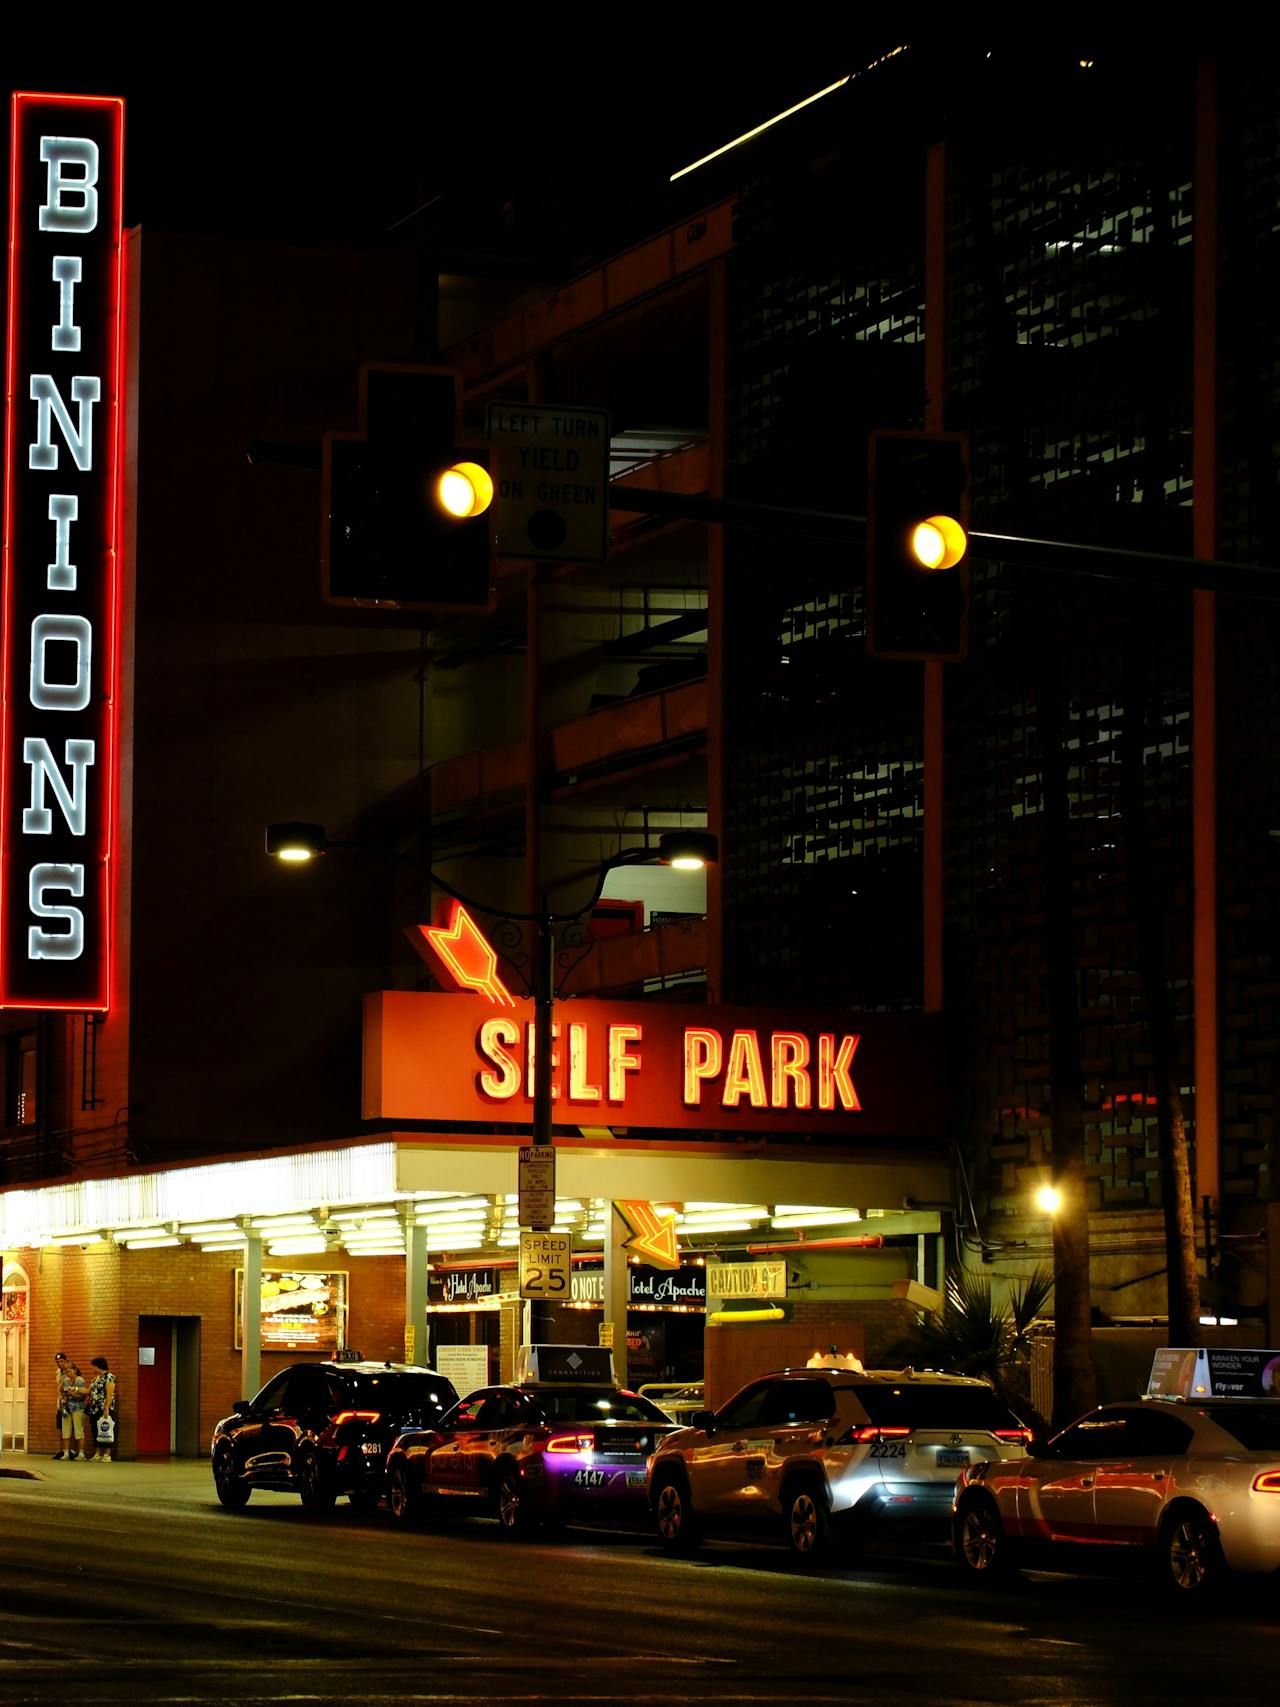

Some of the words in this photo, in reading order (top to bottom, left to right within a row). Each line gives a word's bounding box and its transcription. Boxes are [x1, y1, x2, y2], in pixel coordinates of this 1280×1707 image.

[498, 414, 542, 433] LEFT
[552, 416, 599, 438] TURN
[519, 447, 579, 471] YIELD
[499, 479, 523, 498] ON
[538, 482, 596, 505] GREEN
[22, 136, 101, 961] BINIONS
[683, 1026, 861, 1111] PARK
[520, 1149, 530, 1161] NO
[524, 1240, 567, 1251] SPEED
[529, 1254, 562, 1264] LIMIT
[466, 1272, 492, 1300] Apache
[524, 1267, 567, 1292] 25
[580, 1276, 598, 1300] NOT
[653, 1276, 706, 1302] Apache
[710, 1267, 758, 1293] CAUTION
[869, 1444, 907, 1459] 2224
[574, 1469, 605, 1486] 4147
